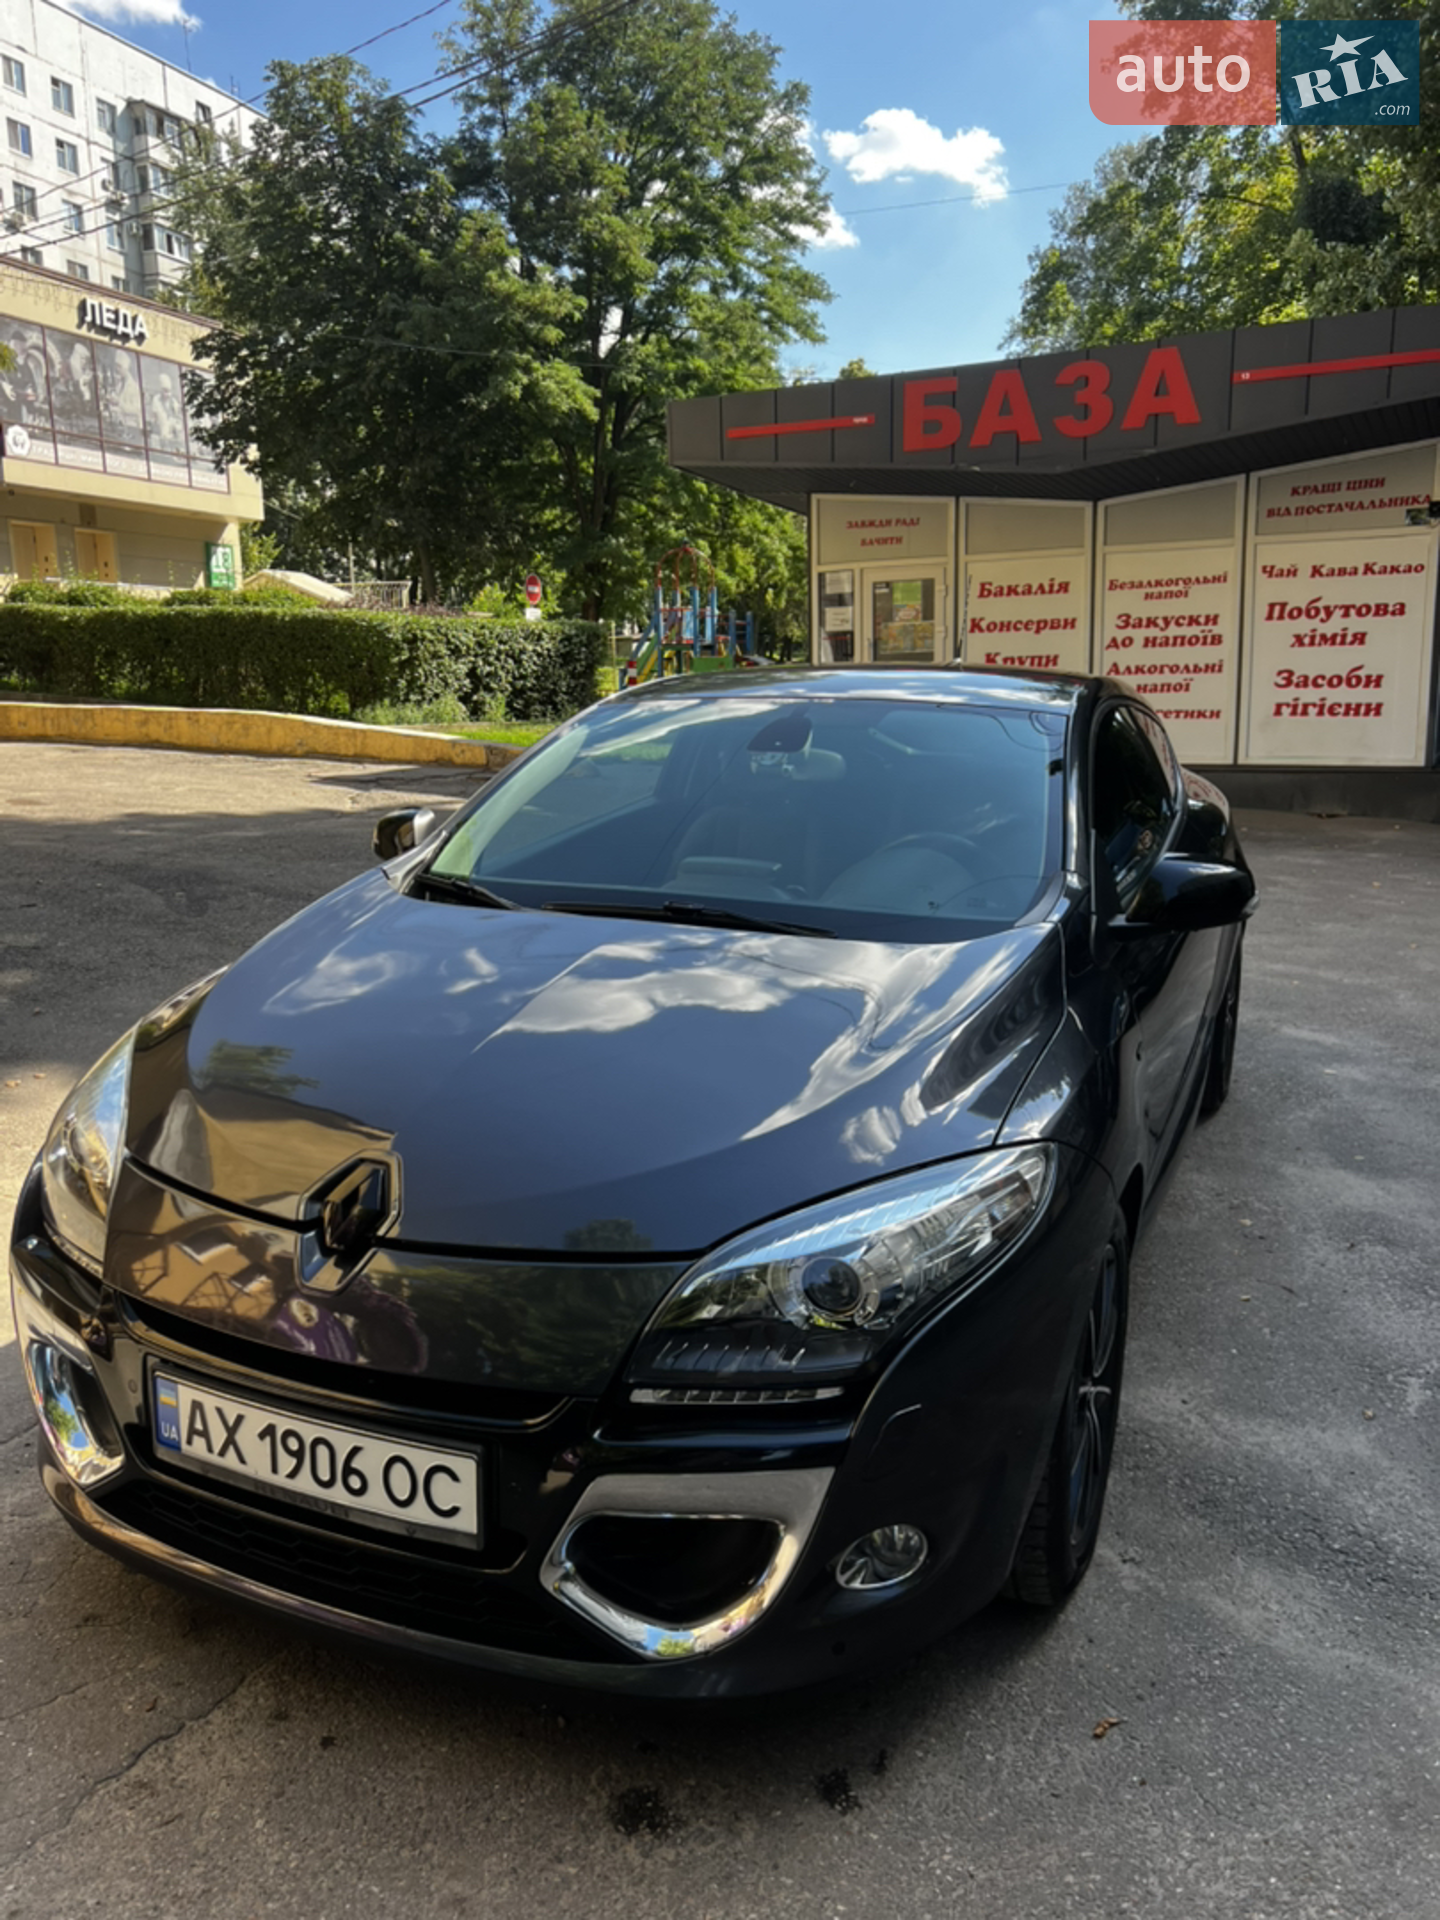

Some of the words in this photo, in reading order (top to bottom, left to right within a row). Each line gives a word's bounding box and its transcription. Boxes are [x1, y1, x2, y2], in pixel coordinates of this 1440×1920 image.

[84, 298, 149, 338] ЛЕДА
[902, 345, 1201, 453] БАЗА
[1290, 481, 1342, 497] КРАЩІ
[1345, 477, 1387, 491] ЦІНИ
[1266, 507, 1292, 518] ВІД
[1294, 494, 1432, 517] ПОСТАЧАЛЬНИКА
[846, 518, 892, 530] ЗАВЖДИ
[895, 517, 920, 528] РАДІ
[1261, 563, 1299, 579] Чай
[1309, 564, 1359, 578] Кава
[1362, 562, 1425, 576] Какао
[978, 577, 1071, 599] Бакалія
[1108, 571, 1228, 591] Безалкогольні
[1144, 586, 1191, 601] напої
[1264, 596, 1406, 623] Побутова
[969, 617, 1077, 635] Консерви
[1115, 613, 1220, 631] Закуски
[1106, 635, 1134, 650] до
[1142, 629, 1223, 648] напоїв
[1290, 627, 1368, 648] хімія
[1106, 659, 1224, 676] Алкогольні
[1273, 665, 1384, 689] Засоби
[1136, 678, 1194, 694] напої
[1273, 697, 1384, 717] гігієни
[161, 1421, 179, 1442] UA
[185, 1399, 248, 1466] AX
[257, 1422, 369, 1497] 1906
[382, 1454, 461, 1519] OC
